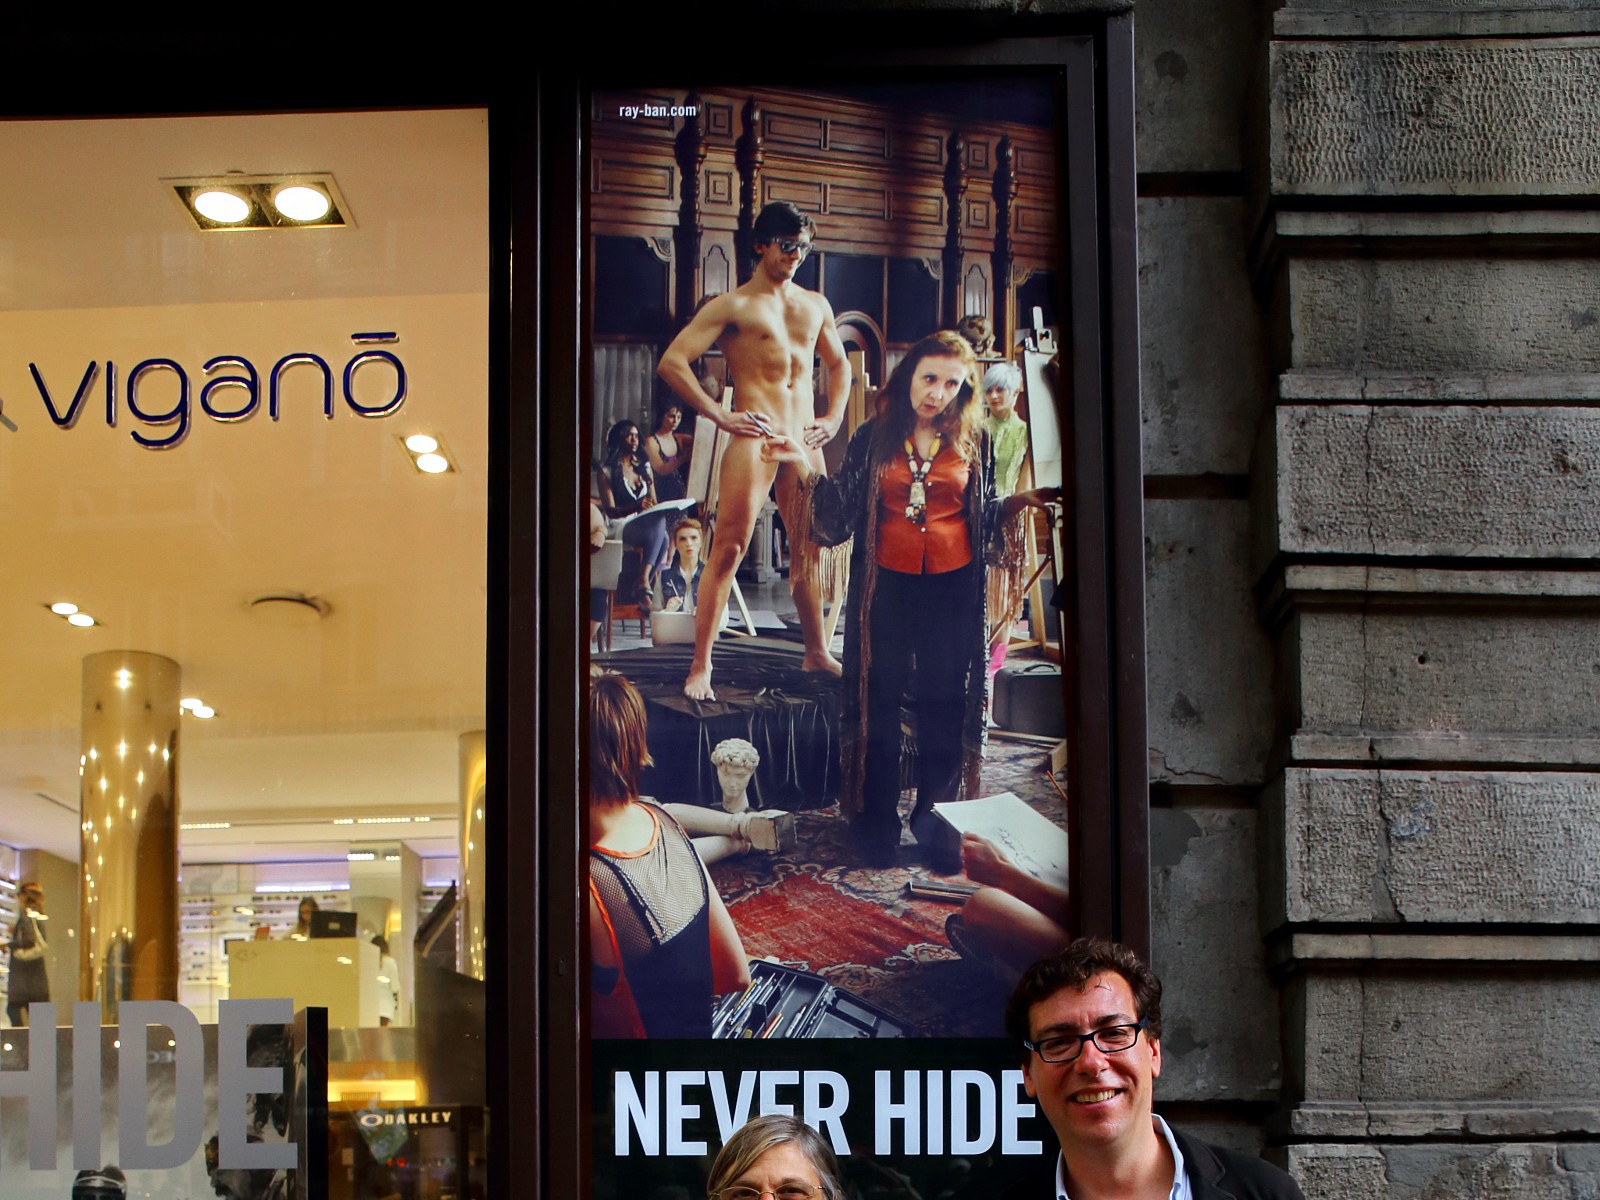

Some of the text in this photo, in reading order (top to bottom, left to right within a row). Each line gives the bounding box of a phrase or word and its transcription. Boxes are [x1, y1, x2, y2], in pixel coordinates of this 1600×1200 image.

[619, 103, 697, 120] ray-ban.com
[614, 1070, 1043, 1156] NEVER HIDE
